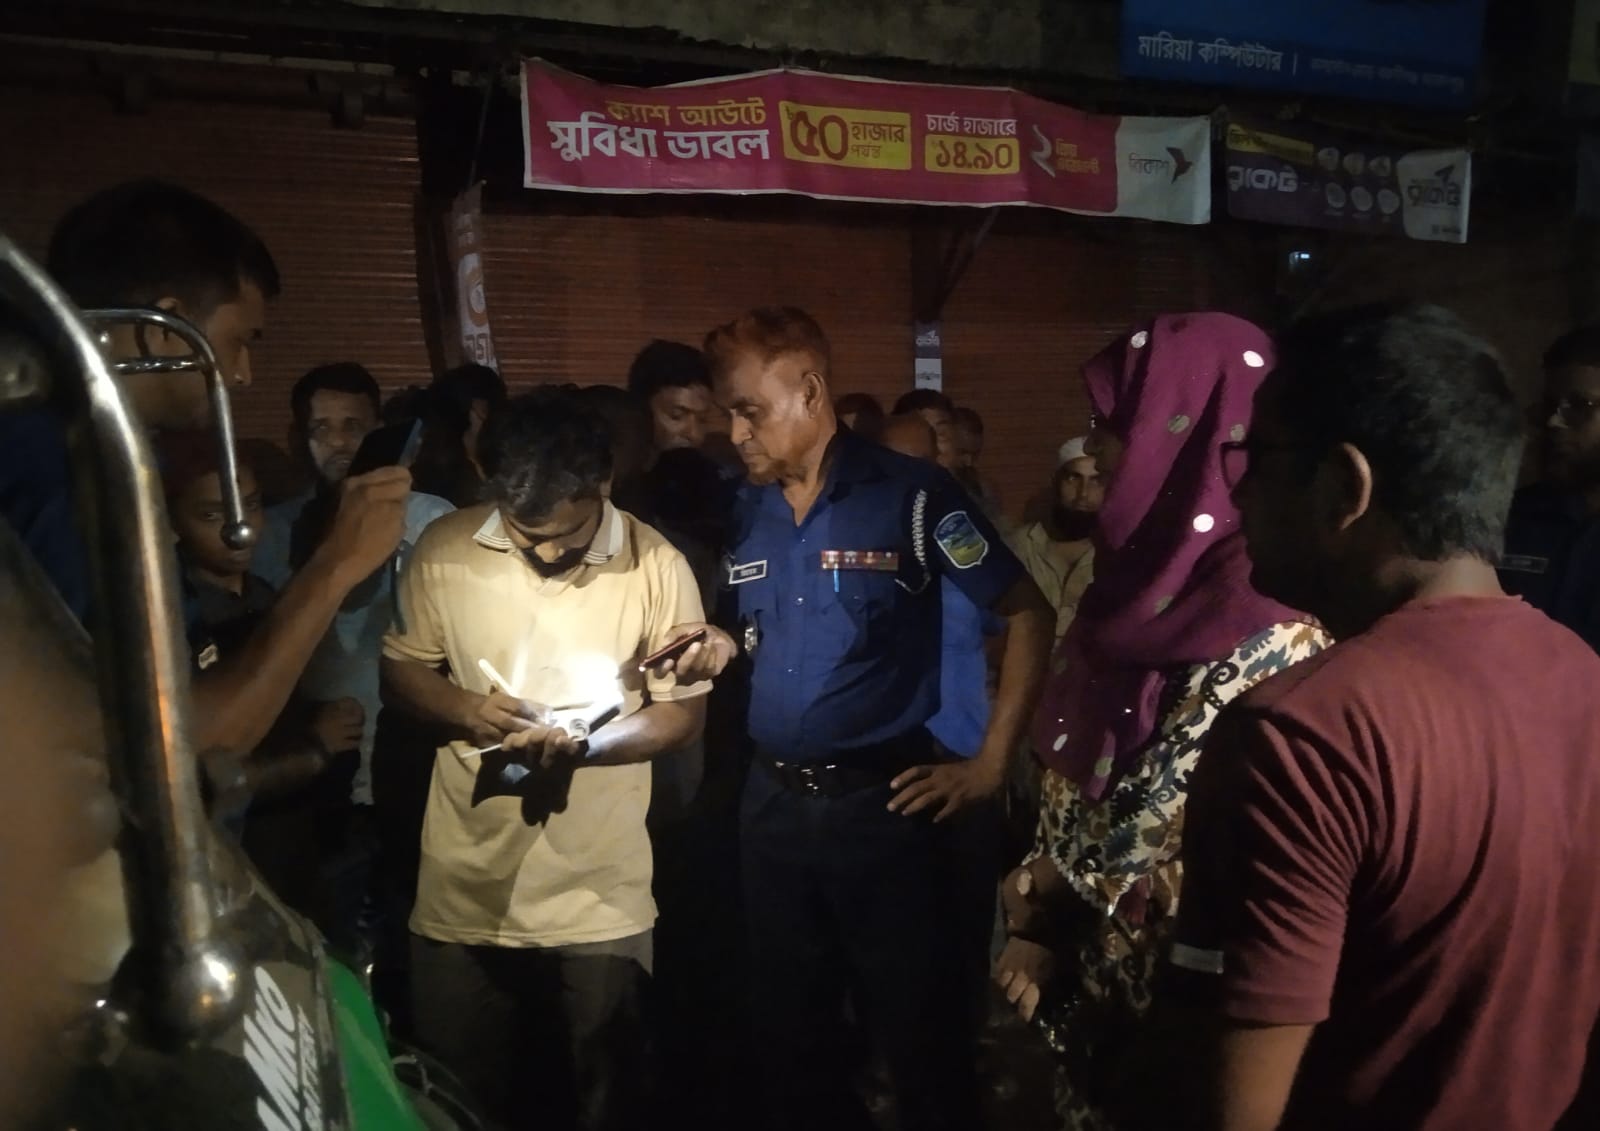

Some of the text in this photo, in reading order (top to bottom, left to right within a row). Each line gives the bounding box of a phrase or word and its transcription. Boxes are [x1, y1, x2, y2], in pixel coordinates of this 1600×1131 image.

[1138, 30, 1194, 62] মারিয়া
[605, 96, 766, 126] ক্যাশ আউটে
[925, 111, 1017, 136] চার্জ হাজারে
[547, 111, 770, 162] সুবিধা ডাবল
[850, 121, 906, 143] হাজার
